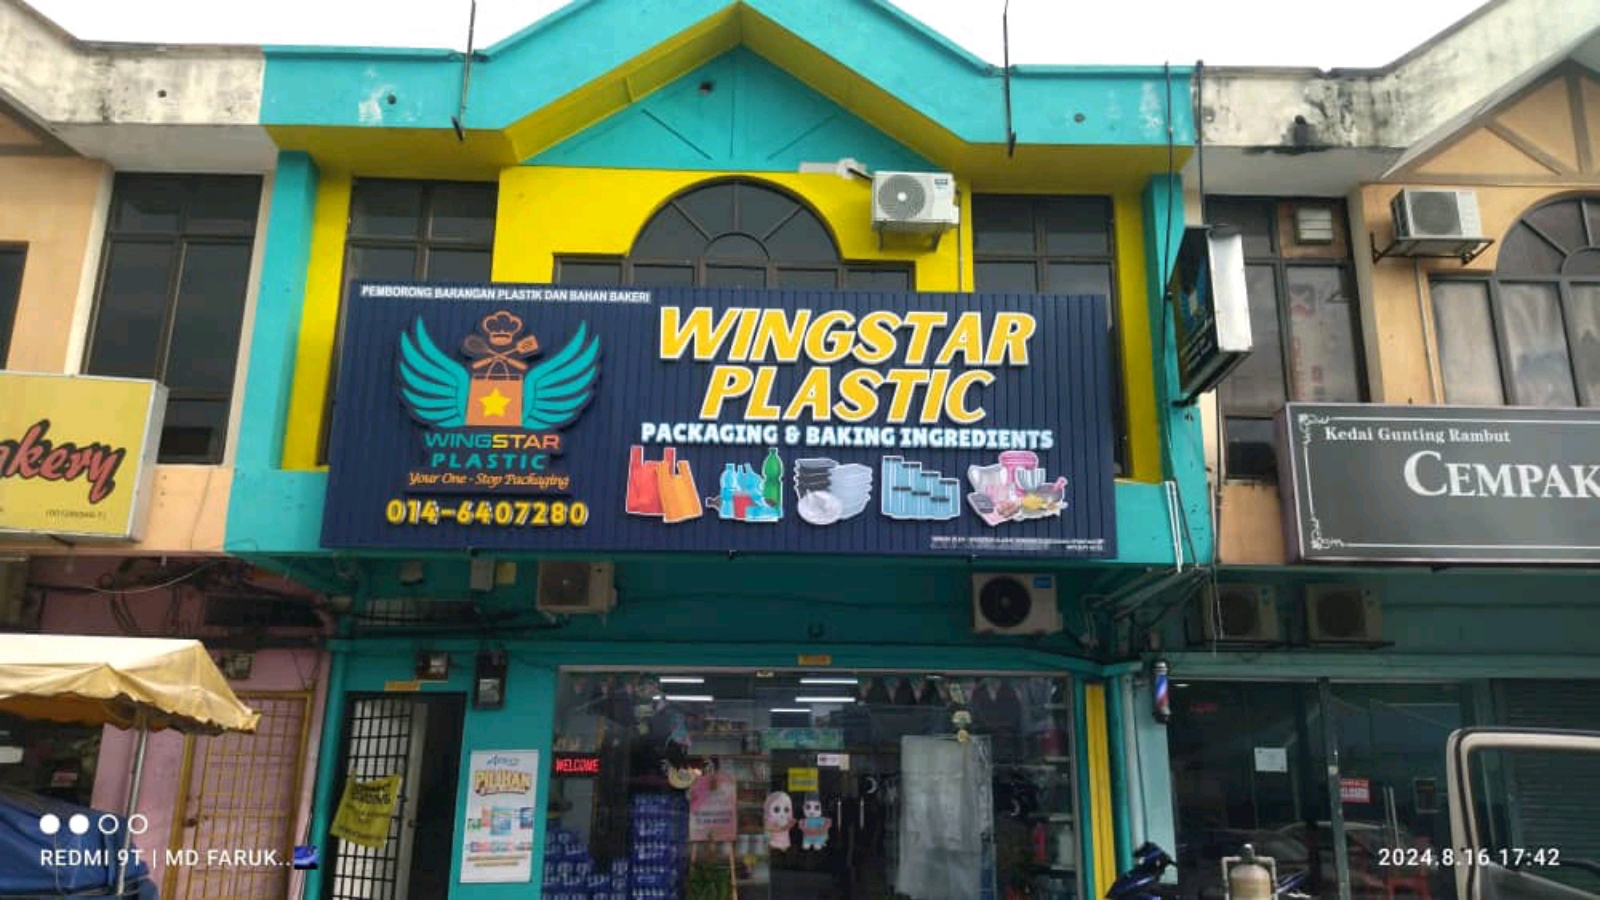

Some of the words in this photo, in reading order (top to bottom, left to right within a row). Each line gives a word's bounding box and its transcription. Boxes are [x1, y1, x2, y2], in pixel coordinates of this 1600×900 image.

[361, 285, 433, 298] PEMBORONG
[434, 287, 496, 299] BARANGAN
[497, 289, 543, 301] PLASTIK
[544, 289, 568, 301] DAN
[569, 289, 607, 302] BAHAN
[608, 291, 650, 303] BAKERI
[659, 306, 1036, 365] WINGSTAR
[700, 365, 995, 423] PLASTIC
[424, 432, 561, 449] WINGSTAR
[641, 422, 779, 444] PACKAGING
[784, 425, 801, 445] &
[805, 426, 896, 447] BAKING
[898, 427, 1054, 450] INGREDIENTS
[1324, 427, 1373, 441] Kedai
[1378, 427, 1445, 444] Gunting
[1449, 429, 1511, 443] Rambut
[430, 452, 550, 470] PLASTIC
[408, 472, 438, 485] Your
[441, 472, 467, 485] One
[476, 472, 502, 488] Stop
[504, 473, 570, 490] Packaging
[386, 499, 590, 526] 014-6407280
[556, 758, 600, 773] WELCOME
